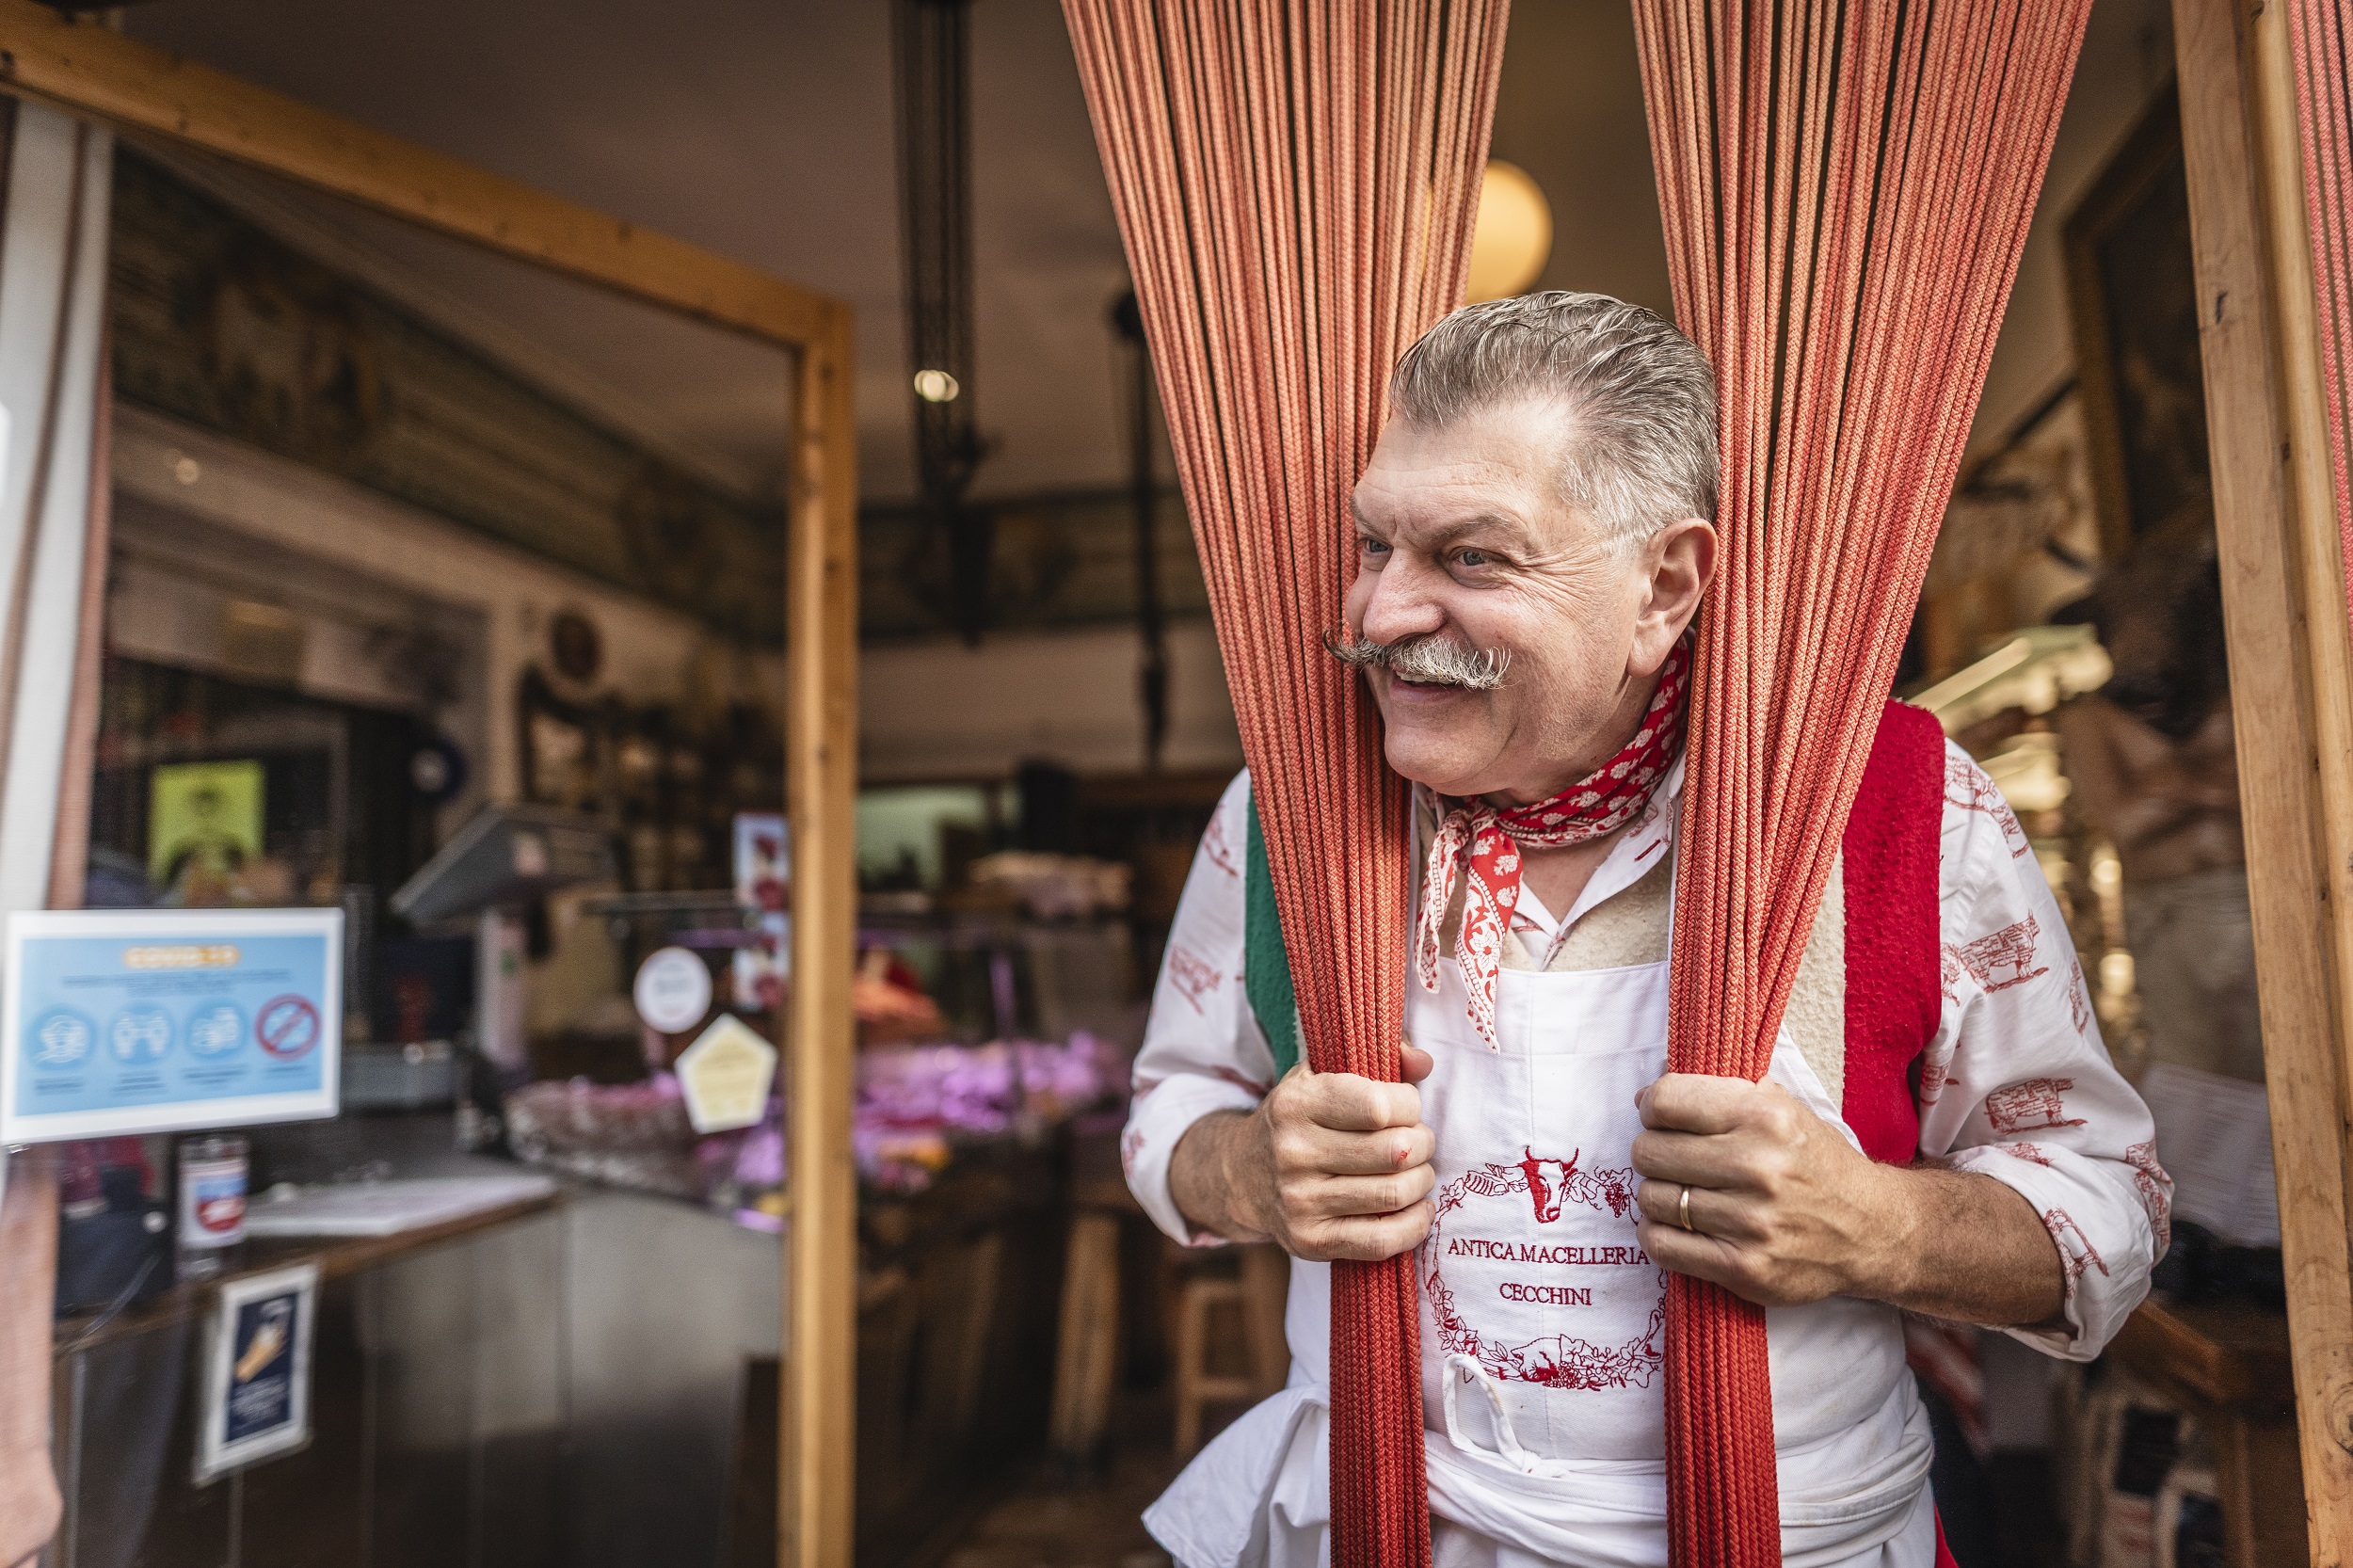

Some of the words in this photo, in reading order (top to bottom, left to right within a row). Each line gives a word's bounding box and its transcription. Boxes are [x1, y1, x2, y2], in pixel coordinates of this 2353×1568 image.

[1448, 1238, 1516, 1261] ANTICA
[1519, 1242, 1650, 1265] MACELLERIA
[1499, 1283, 1593, 1306] CECCHINI
